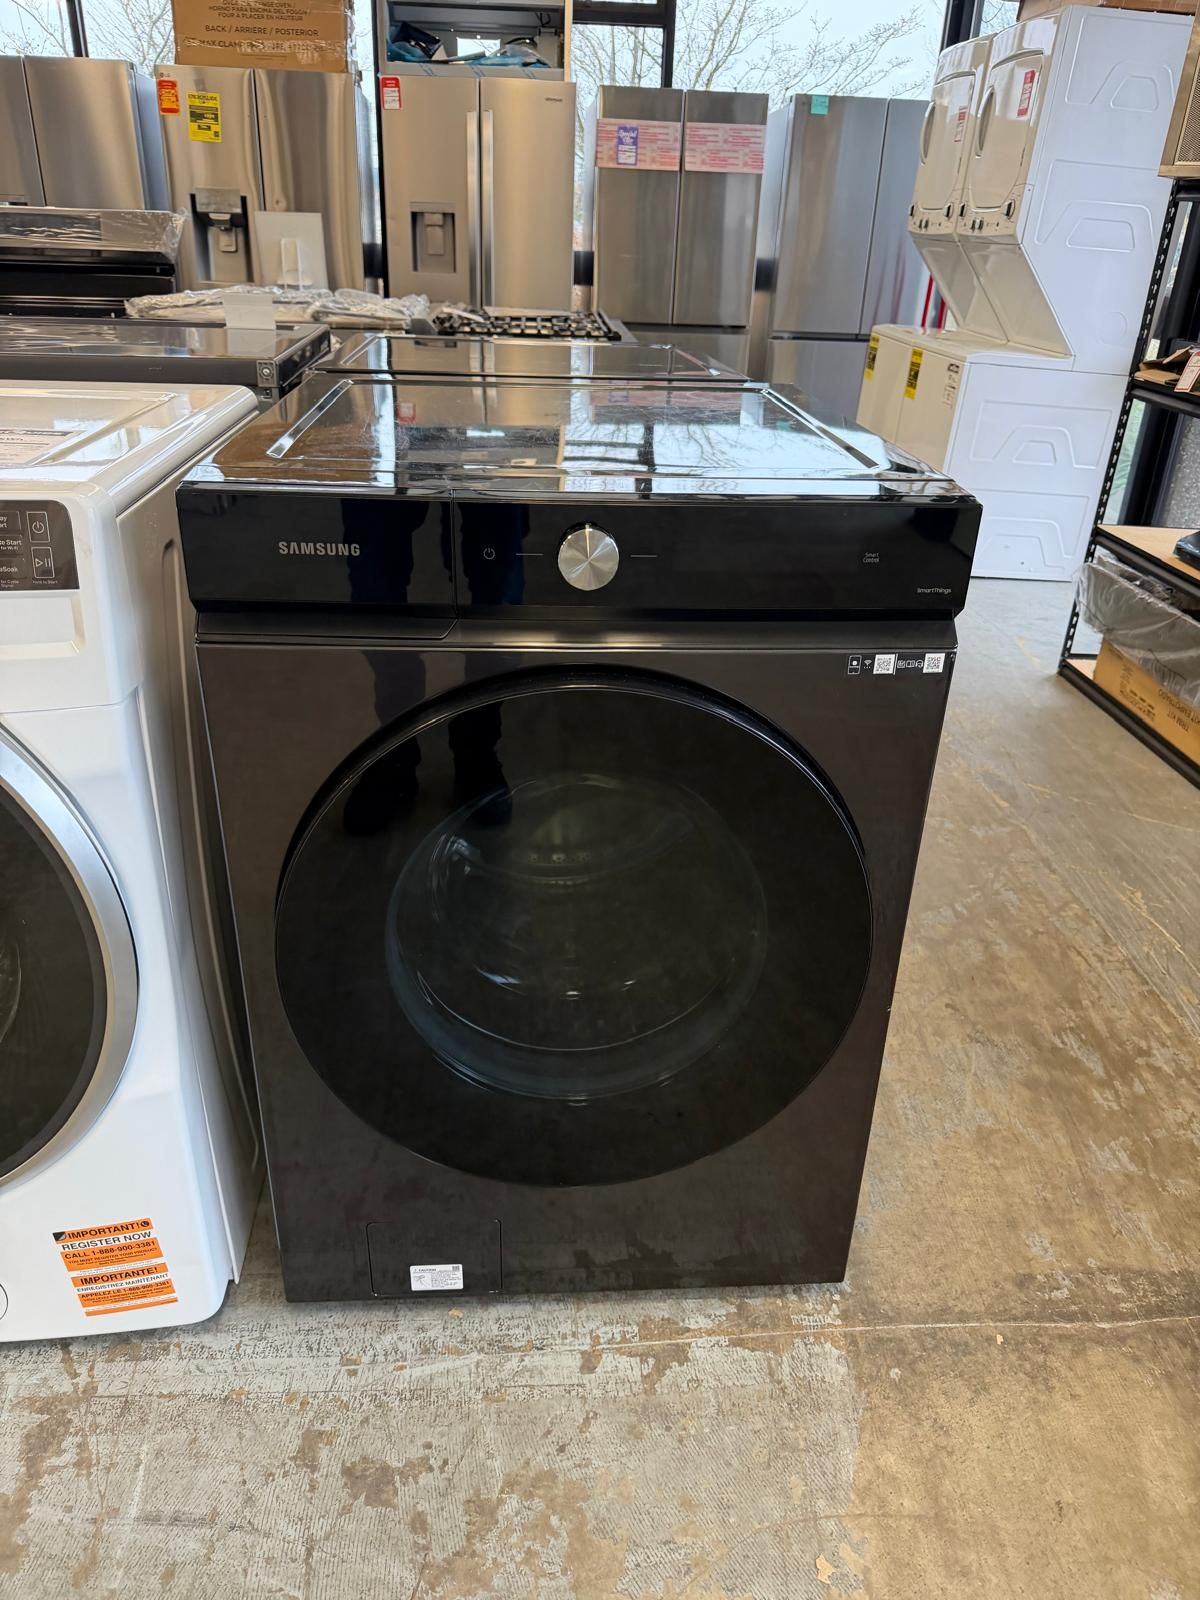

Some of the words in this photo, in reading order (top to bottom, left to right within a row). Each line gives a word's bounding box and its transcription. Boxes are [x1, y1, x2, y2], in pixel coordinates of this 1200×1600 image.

[205, 24, 226, 32] BACK
[275, 27, 319, 37] POSTERIOR
[278, 541, 360, 557] SAMSUNG
[67, 1222, 140, 1240] IMPORTANT!
[61, 1237, 120, 1251] REGISTER
[124, 1231, 151, 1242] NOW
[65, 1252, 90, 1260] CALL
[92, 1240, 156, 1256] 1-888-900-3381
[76, 1281, 123, 1293] ENREGISTREZ
[125, 1273, 169, 1287] MAINTENANT
[80, 1266, 158, 1285] IMPORTANTE!
[81, 1290, 111, 1298] APPELEZ
